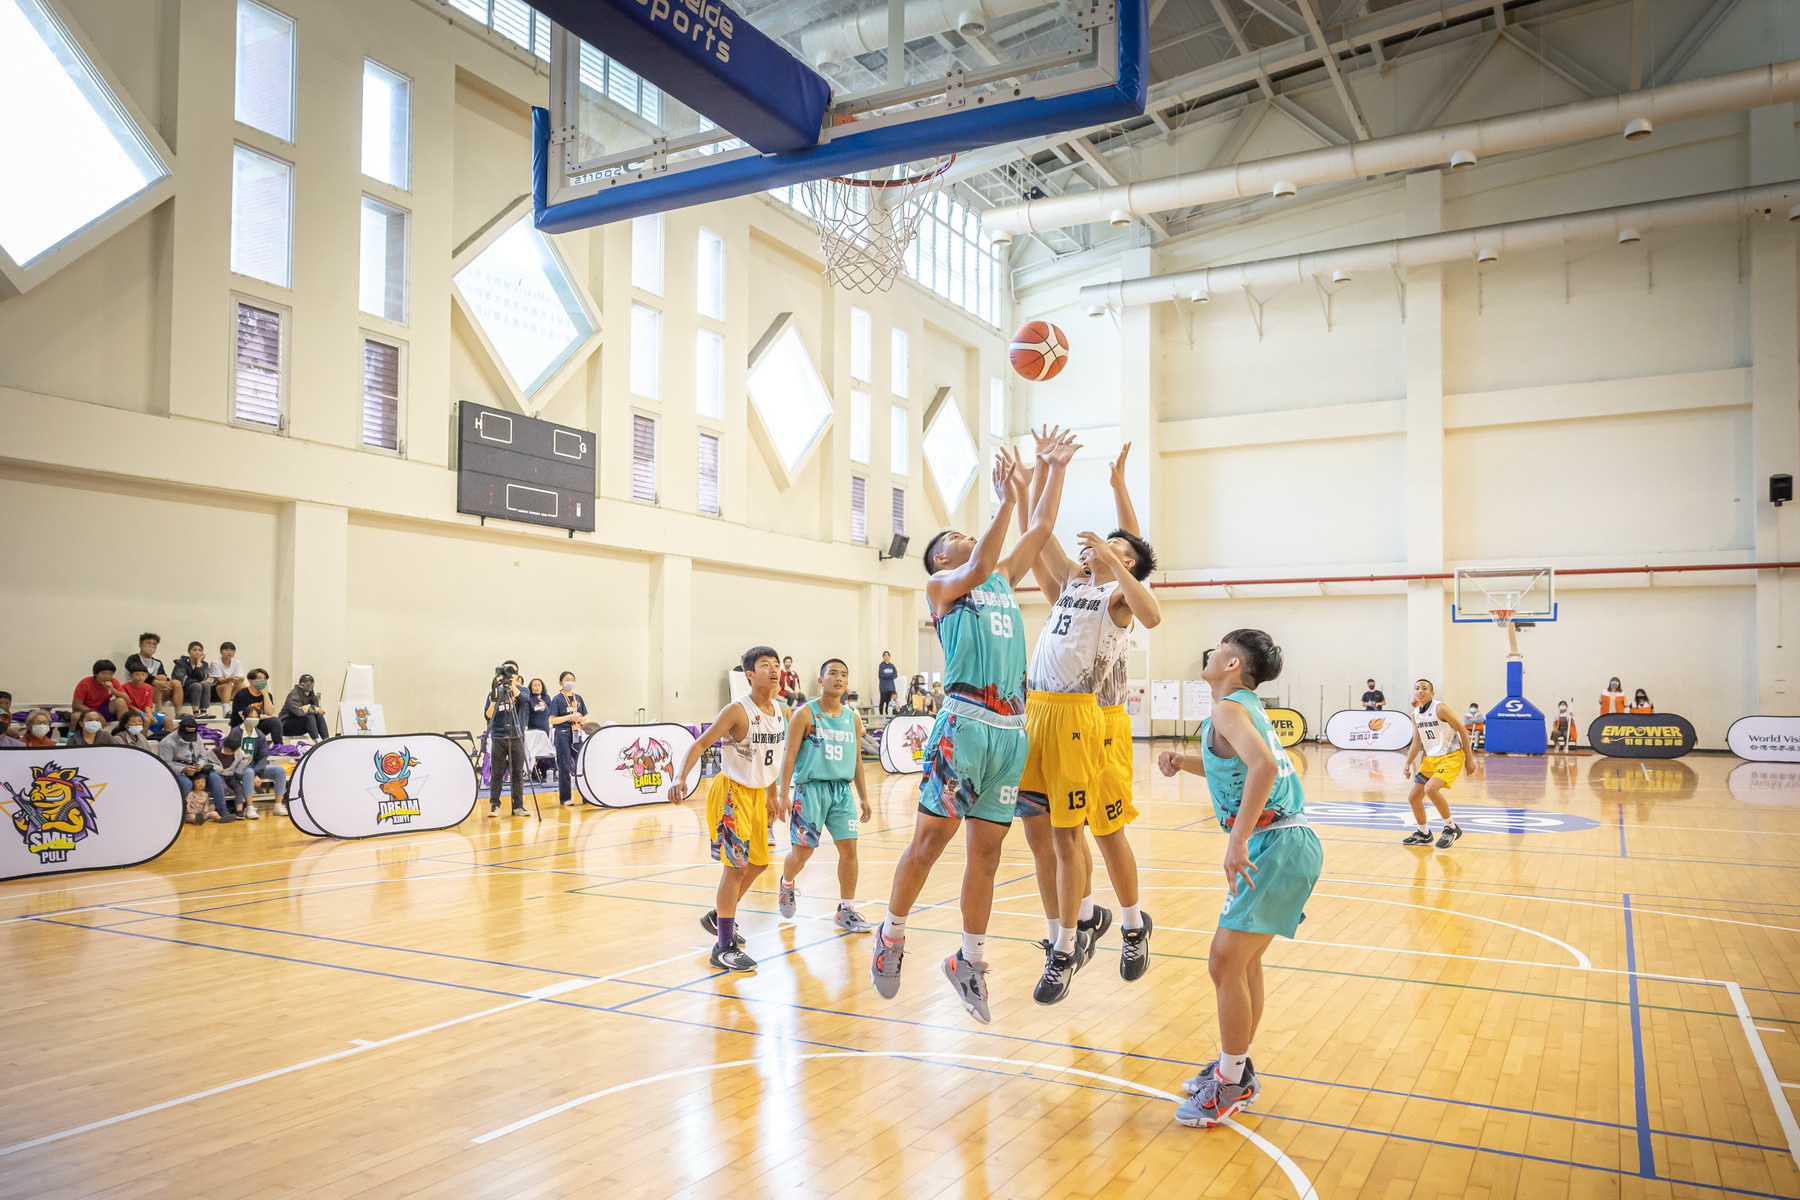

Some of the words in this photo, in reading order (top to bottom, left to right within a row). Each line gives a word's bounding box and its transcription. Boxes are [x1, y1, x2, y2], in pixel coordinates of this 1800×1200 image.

[679, 0, 733, 39] elde
[475, 418, 482, 430] H
[580, 442, 587, 454] G
[990, 611, 1013, 638] 69
[1052, 613, 1072, 635] 13
[1425, 730, 1436, 740] 10
[1601, 725, 1683, 737] EMPOWER
[1748, 734, 1781, 743] World
[764, 749, 774, 766] 8
[825, 744, 843, 761] 99
[635, 773, 661, 788] EAGLES
[999, 785, 1019, 805] 69
[1068, 790, 1086, 811] 13
[379, 799, 419, 816] DREAM
[1105, 799, 1123, 820] 22
[41, 850, 66, 862] PULI
